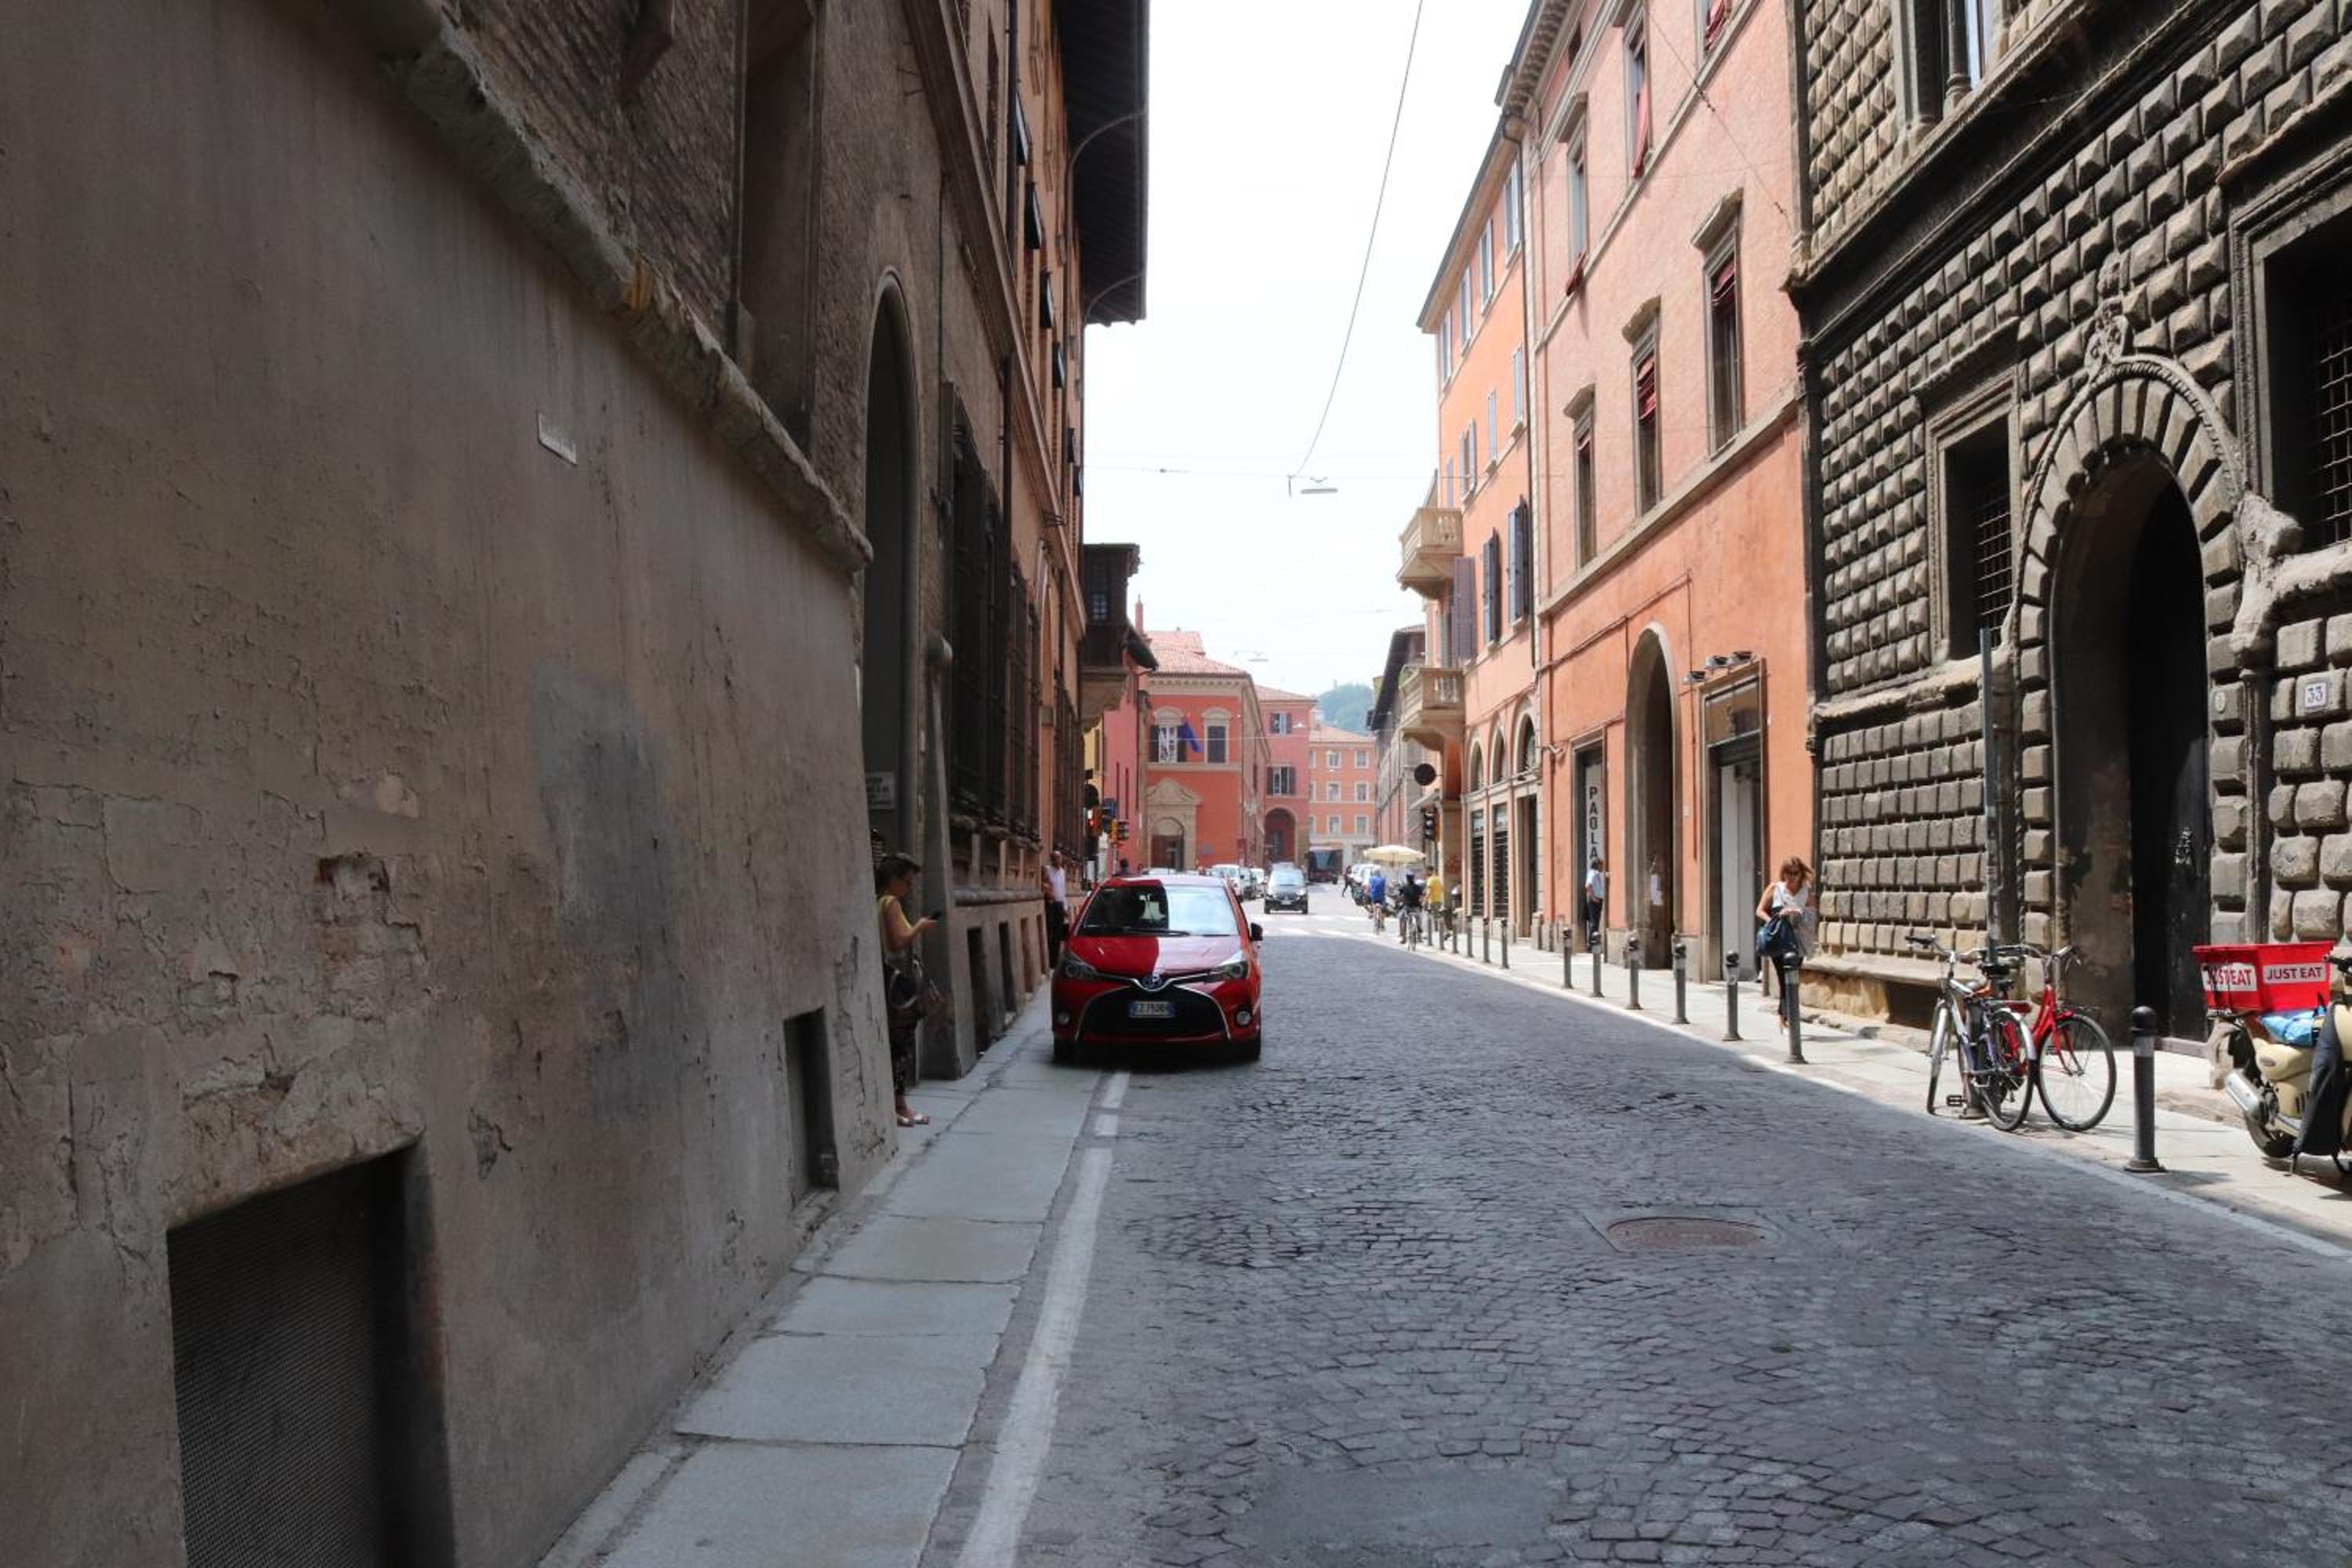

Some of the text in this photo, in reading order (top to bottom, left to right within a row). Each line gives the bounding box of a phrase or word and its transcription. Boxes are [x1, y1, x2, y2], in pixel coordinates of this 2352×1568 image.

[1589, 786, 1599, 860] PAOLA
[2230, 968, 2252, 985] EAT
[2267, 967, 2323, 980] JUST EAT
